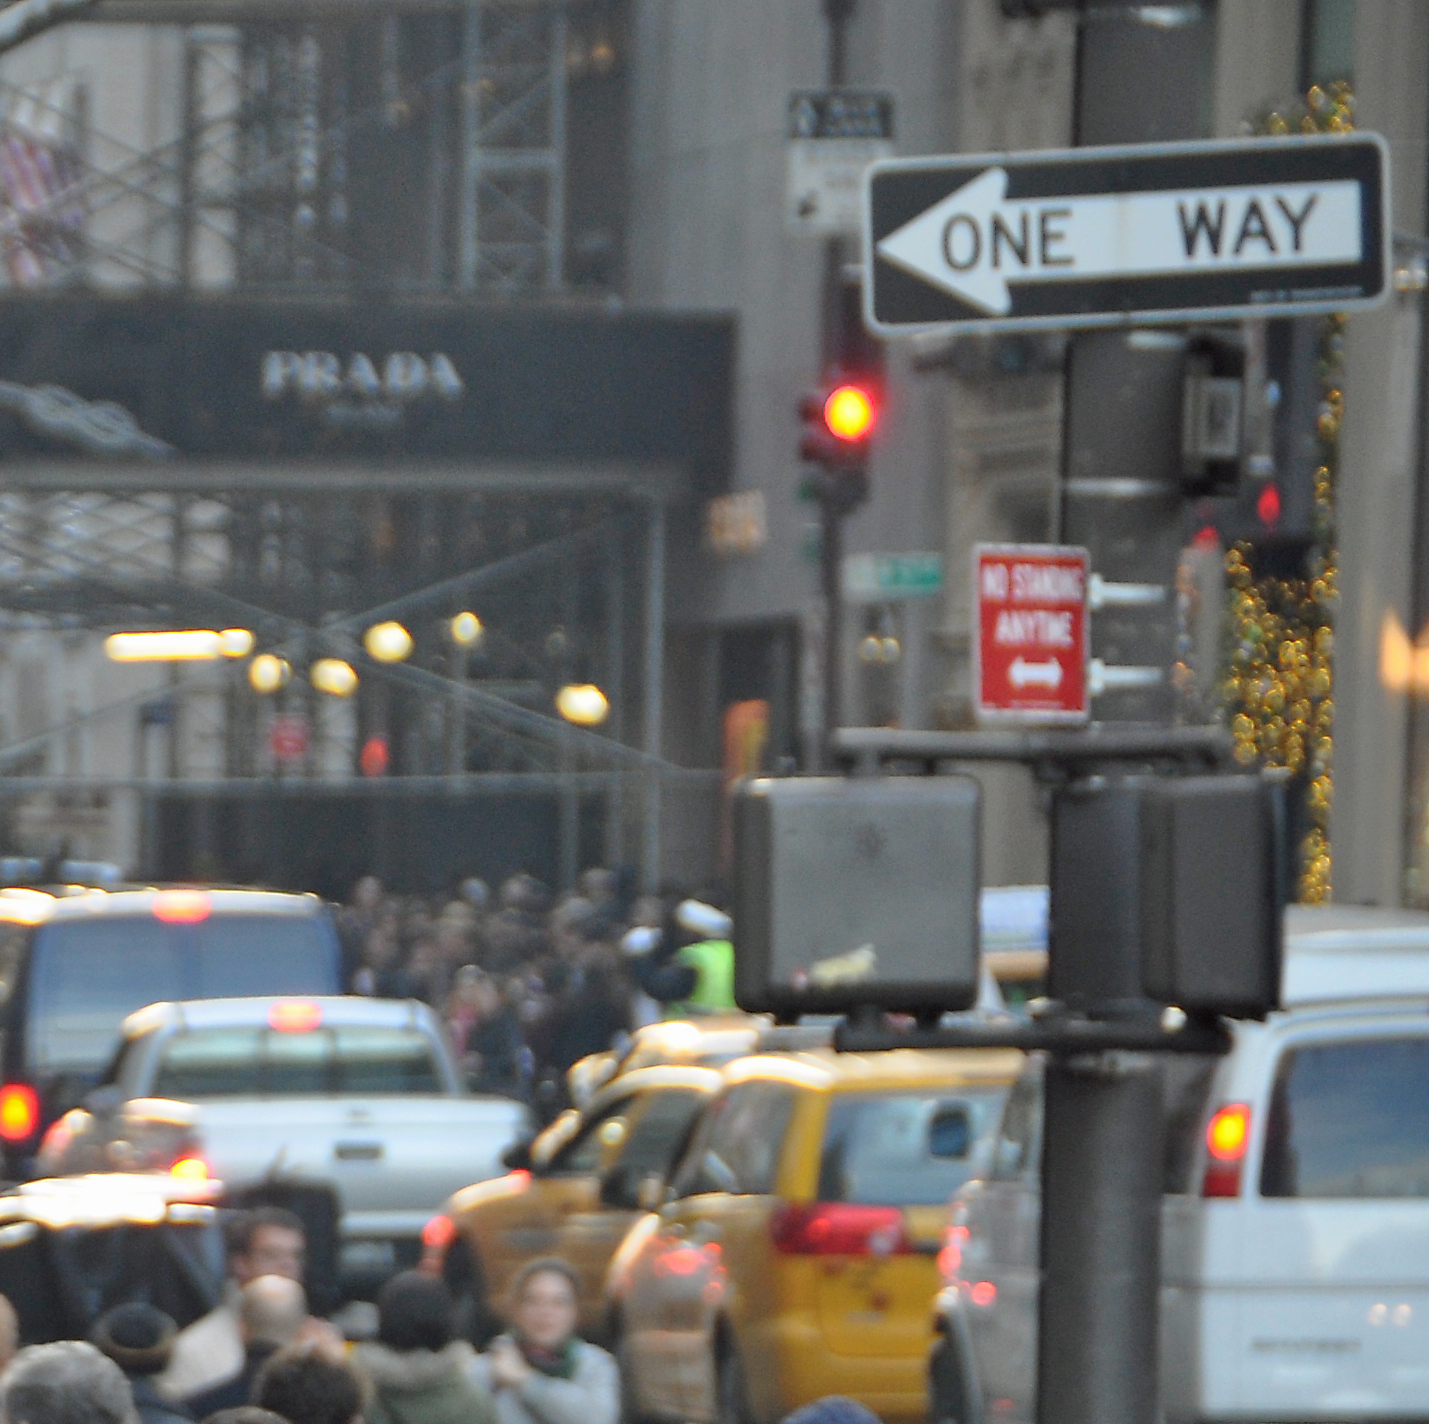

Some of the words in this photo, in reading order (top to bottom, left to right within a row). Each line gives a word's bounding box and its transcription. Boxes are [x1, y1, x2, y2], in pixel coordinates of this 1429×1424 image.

[941, 206, 1077, 273] ONE
[1175, 190, 1322, 259] WAY
[260, 349, 466, 400] PRADA
[981, 562, 1010, 600] NO
[1011, 562, 1084, 602] STANDING
[994, 609, 1075, 647] ANYTIME
